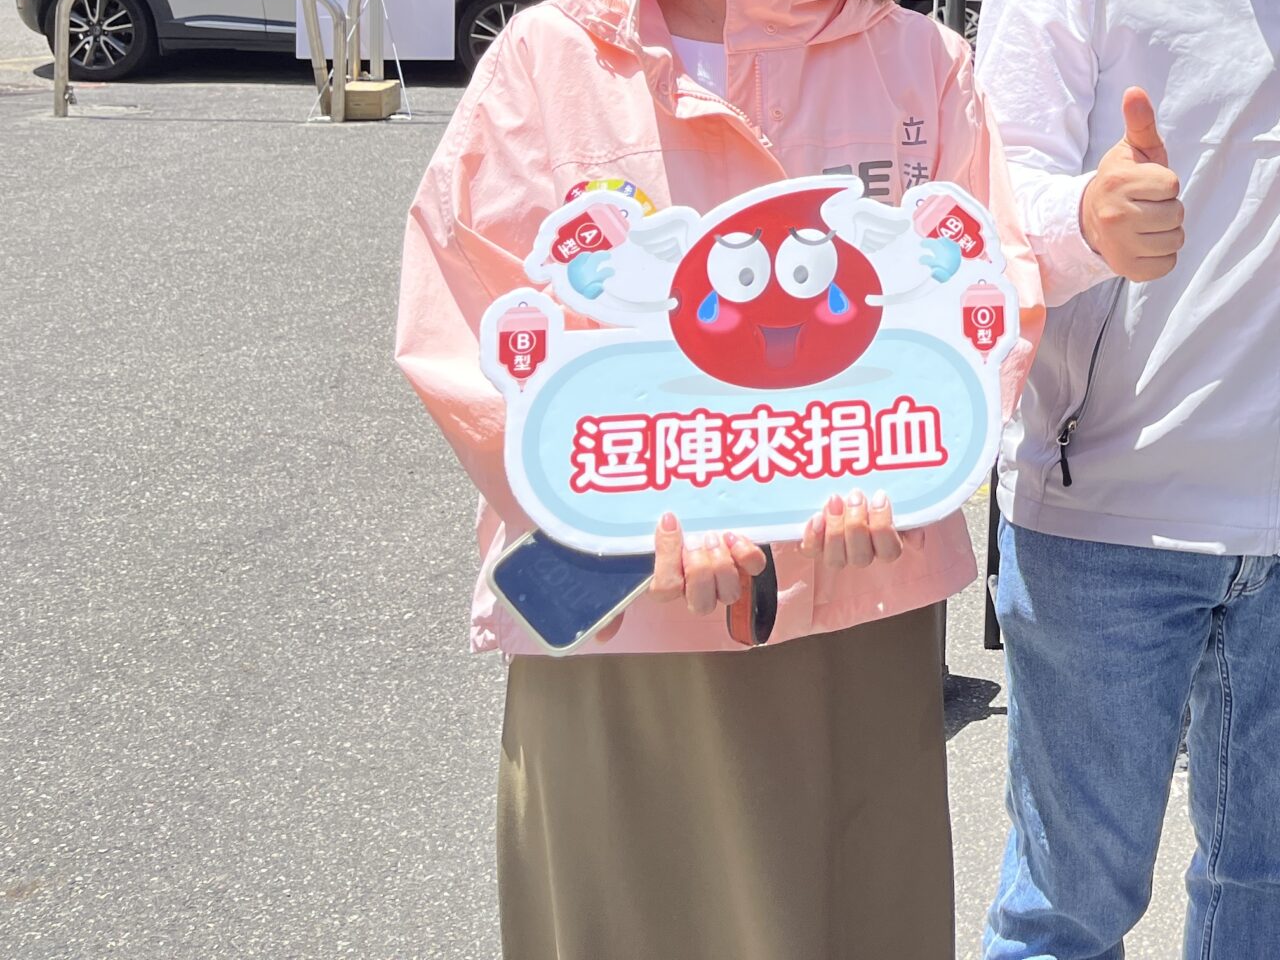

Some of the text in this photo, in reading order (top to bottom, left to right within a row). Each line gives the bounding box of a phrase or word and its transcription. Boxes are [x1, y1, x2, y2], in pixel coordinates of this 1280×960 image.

[571, 394, 948, 494] 逗陣來捐血
